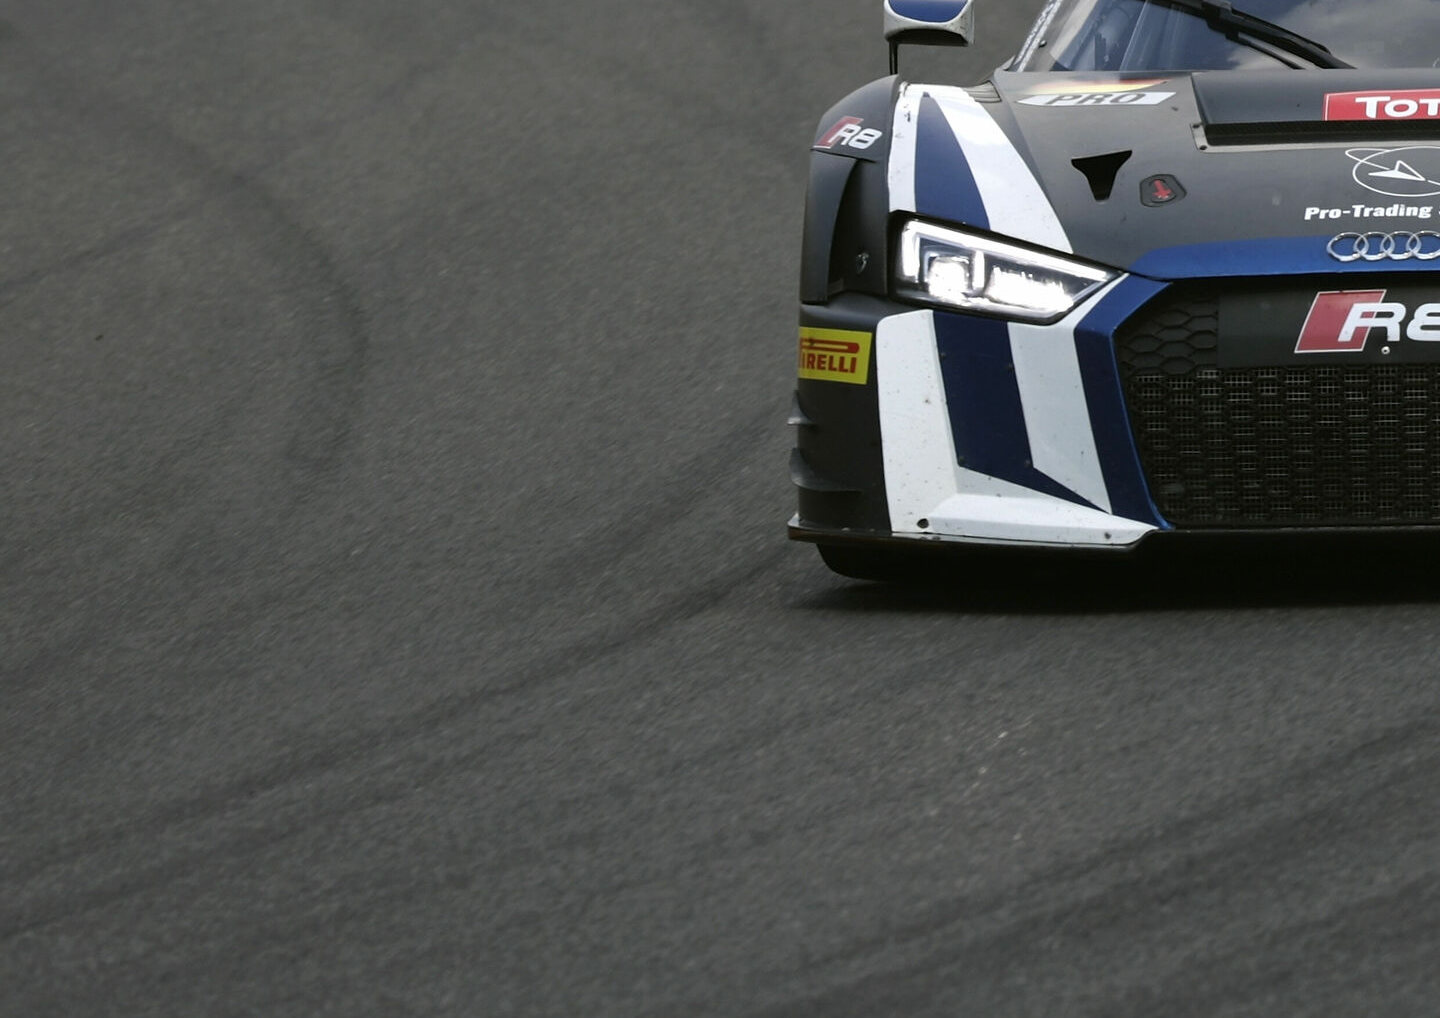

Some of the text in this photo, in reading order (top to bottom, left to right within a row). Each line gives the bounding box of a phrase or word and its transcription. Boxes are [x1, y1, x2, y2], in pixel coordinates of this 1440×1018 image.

[1046, 92, 1147, 105] PRO
[827, 123, 883, 150] R8
[1304, 204, 1433, 220] Pro-Trading
